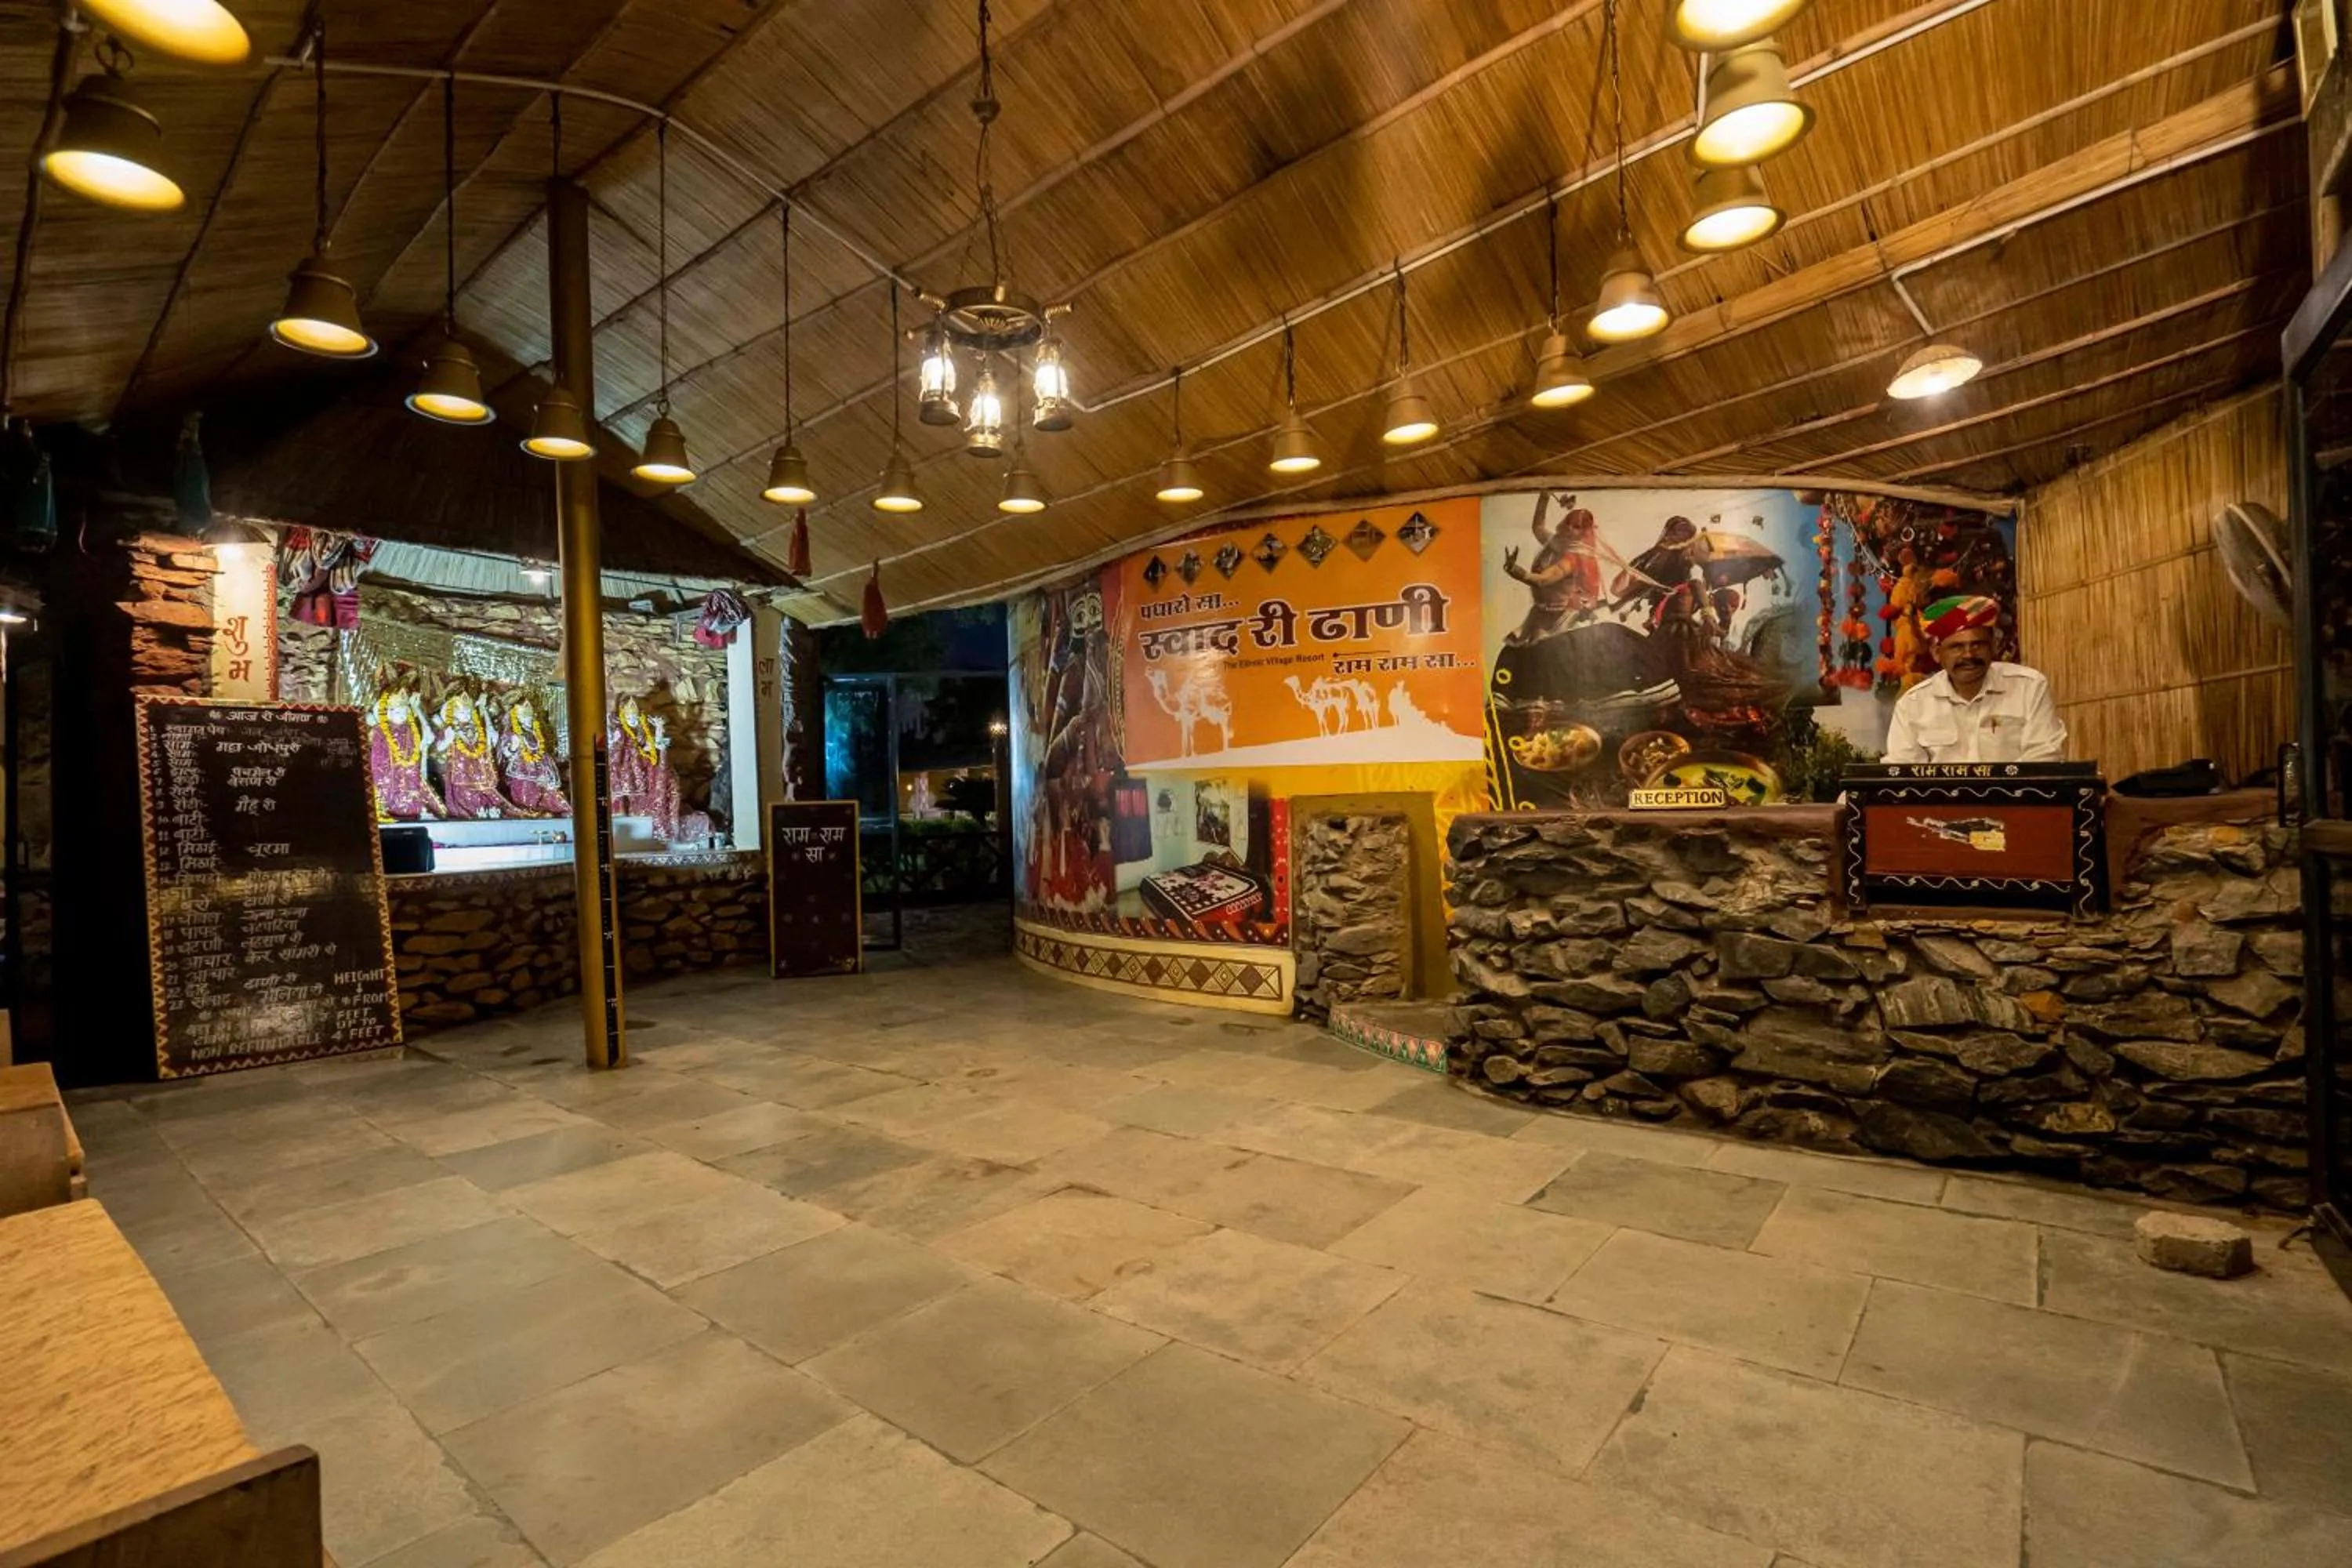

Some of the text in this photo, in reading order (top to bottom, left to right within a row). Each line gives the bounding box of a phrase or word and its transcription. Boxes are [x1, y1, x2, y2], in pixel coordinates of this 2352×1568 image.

[1140, 594, 1191, 619] पधारो
[1138, 584, 1450, 661] स्वाद री ढाणी
[222, 616, 252, 682] शुभ
[1265, 656, 1293, 666] Village
[1295, 653, 1324, 663] Resort
[1333, 660, 1371, 676] राम
[1378, 657, 1417, 673] राम
[226, 711, 258, 722] आज
[1911, 764, 1994, 777] राम राम सा
[1634, 791, 1722, 804] RECEPTION
[782, 827, 848, 844] राम राम
[245, 843, 290, 858] चूरमा
[805, 847, 824, 862] सा
[334, 967, 385, 985] HEIGHT
[352, 992, 390, 1007] FROM
[337, 1007, 372, 1021] FEET
[349, 1024, 385, 1041] FEET
